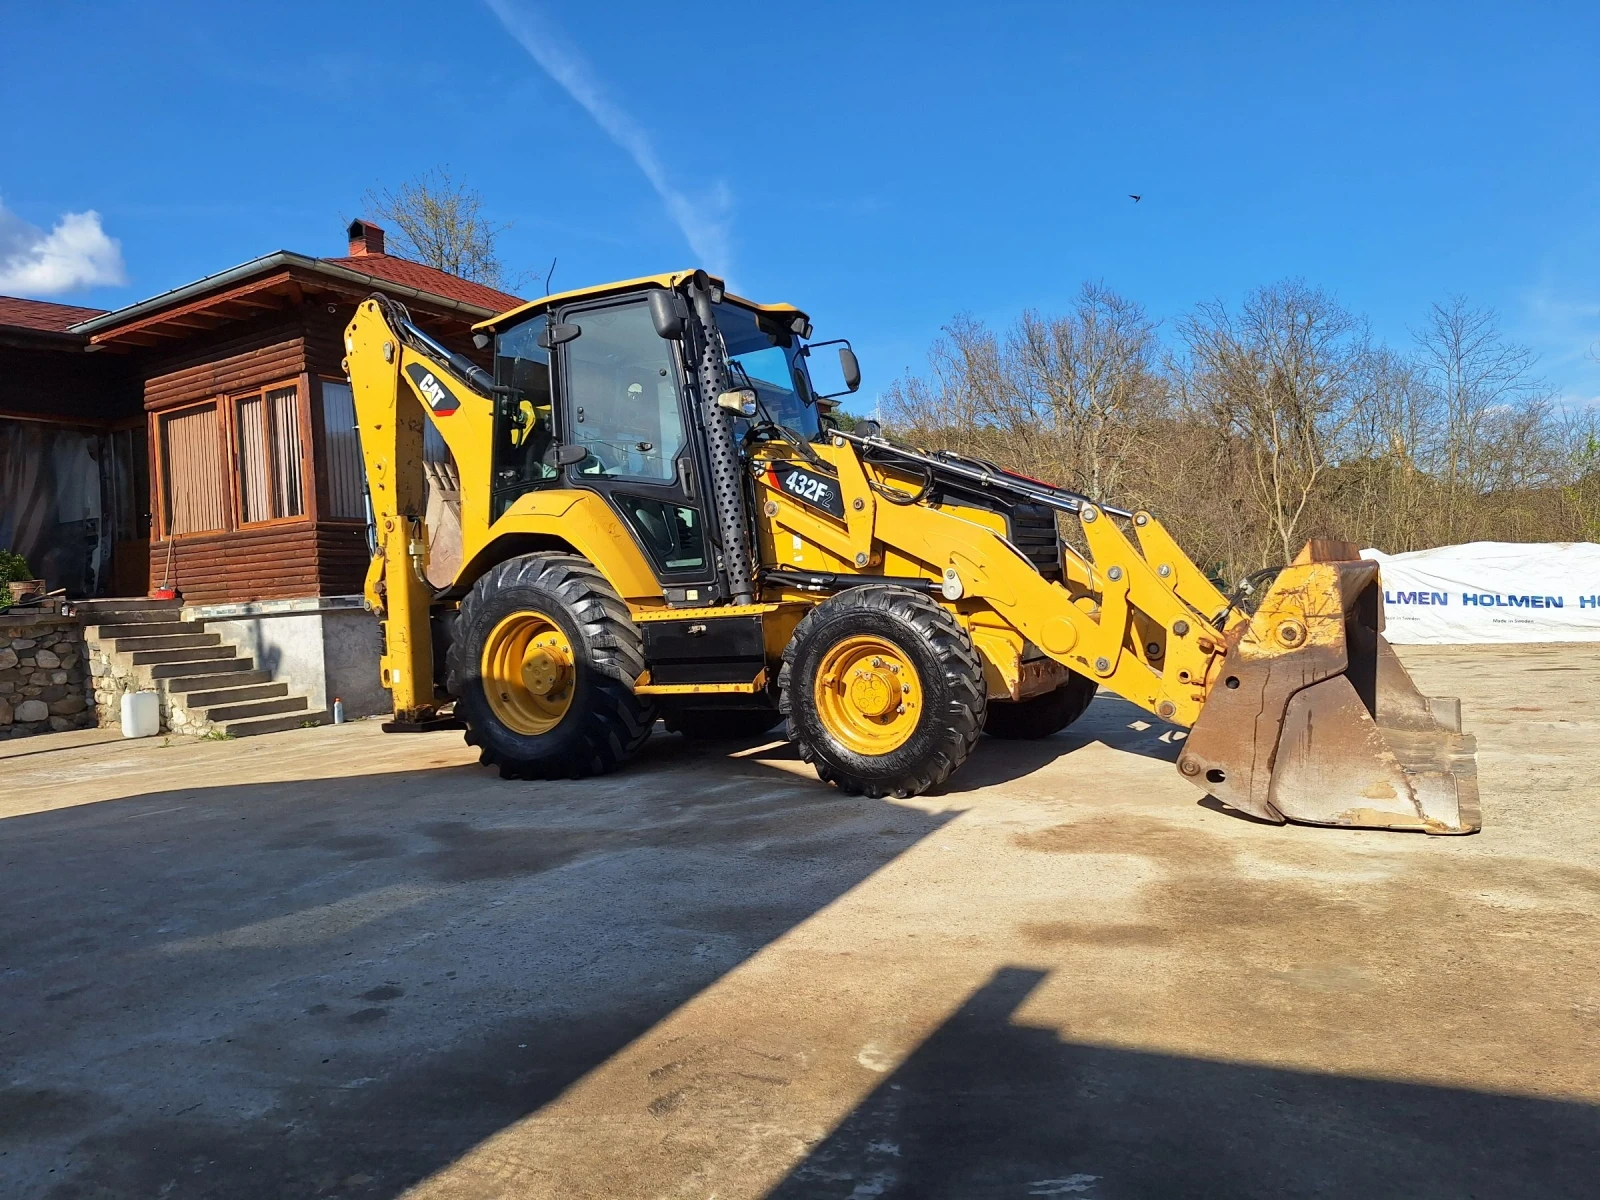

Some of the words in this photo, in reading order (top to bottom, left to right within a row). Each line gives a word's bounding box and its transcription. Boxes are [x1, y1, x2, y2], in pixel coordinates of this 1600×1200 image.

[419, 373, 446, 408] CAT
[785, 471, 834, 508] 432F2
[1385, 591, 1448, 605] LMEN
[1463, 593, 1564, 608] HOLMEN
[1579, 595, 1600, 608] H
